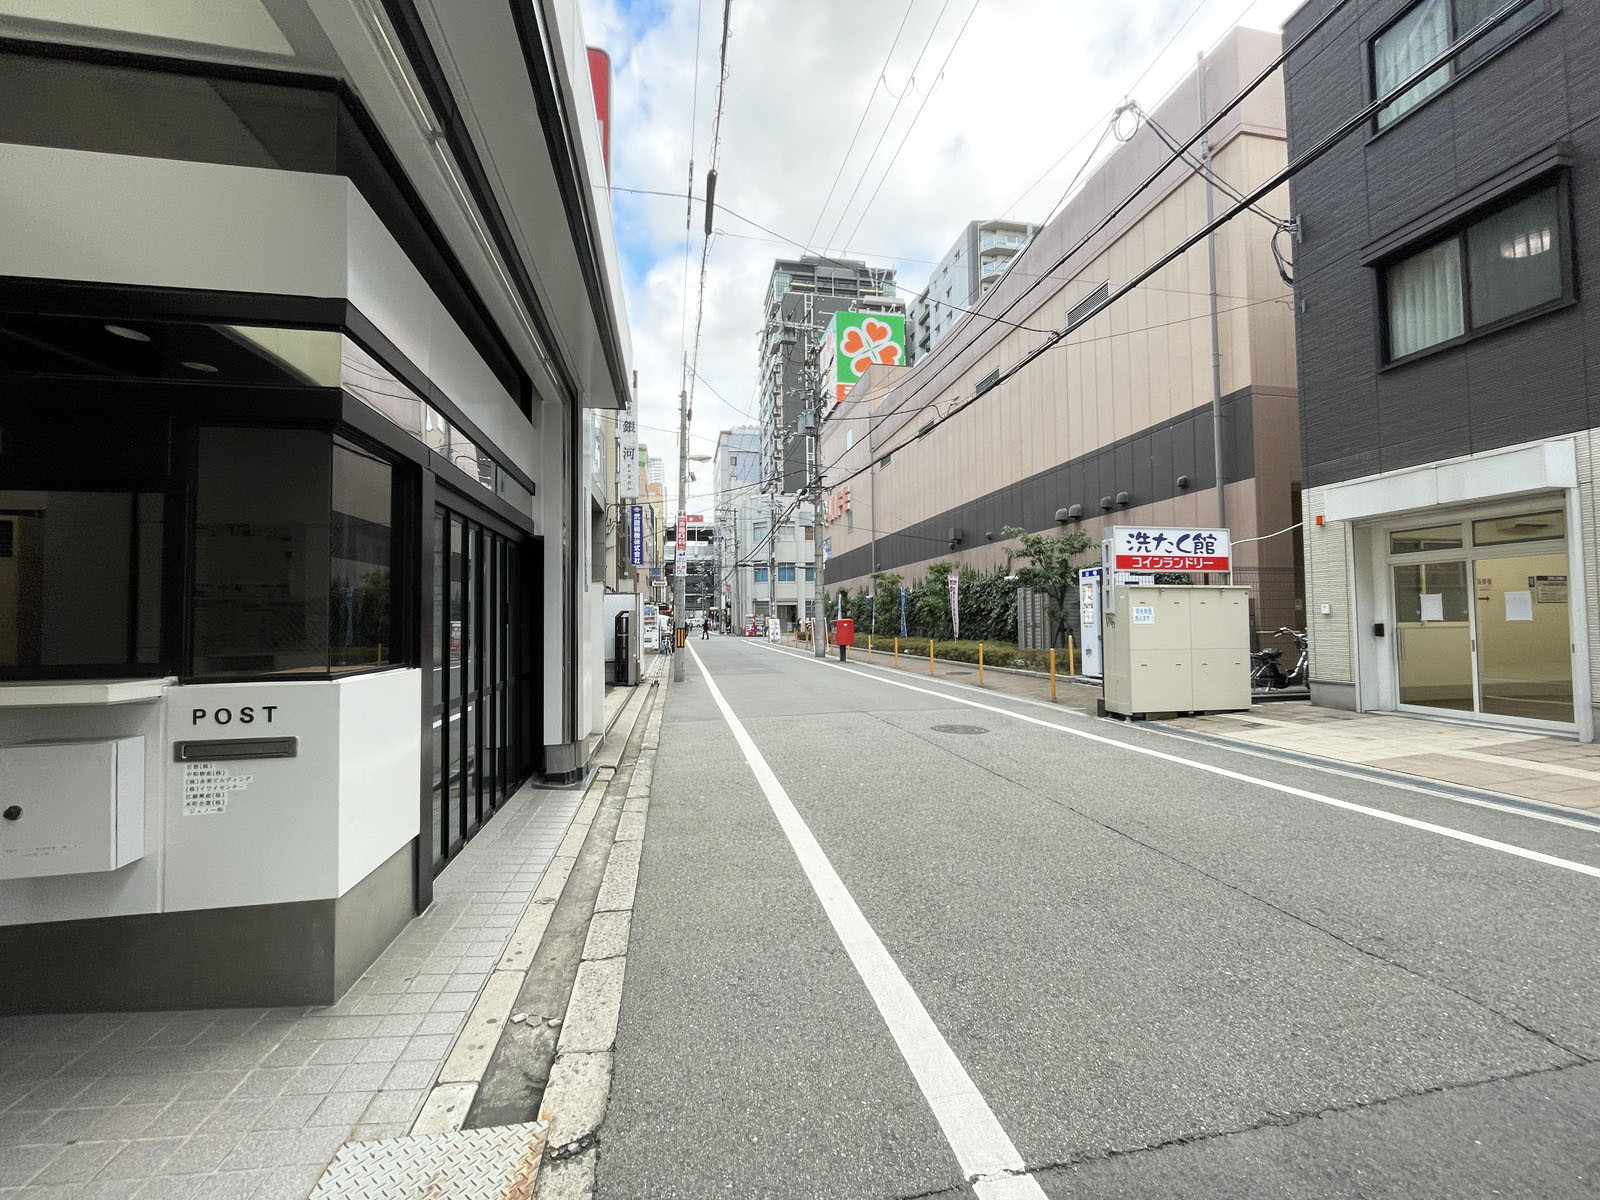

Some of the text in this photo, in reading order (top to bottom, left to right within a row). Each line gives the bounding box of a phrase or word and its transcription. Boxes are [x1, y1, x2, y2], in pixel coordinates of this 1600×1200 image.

[622, 420, 636, 460] 銀河
[1126, 531, 1217, 555] 洗たく館
[1131, 556, 1214, 569] コインランドリー
[192, 706, 278, 725] POST
